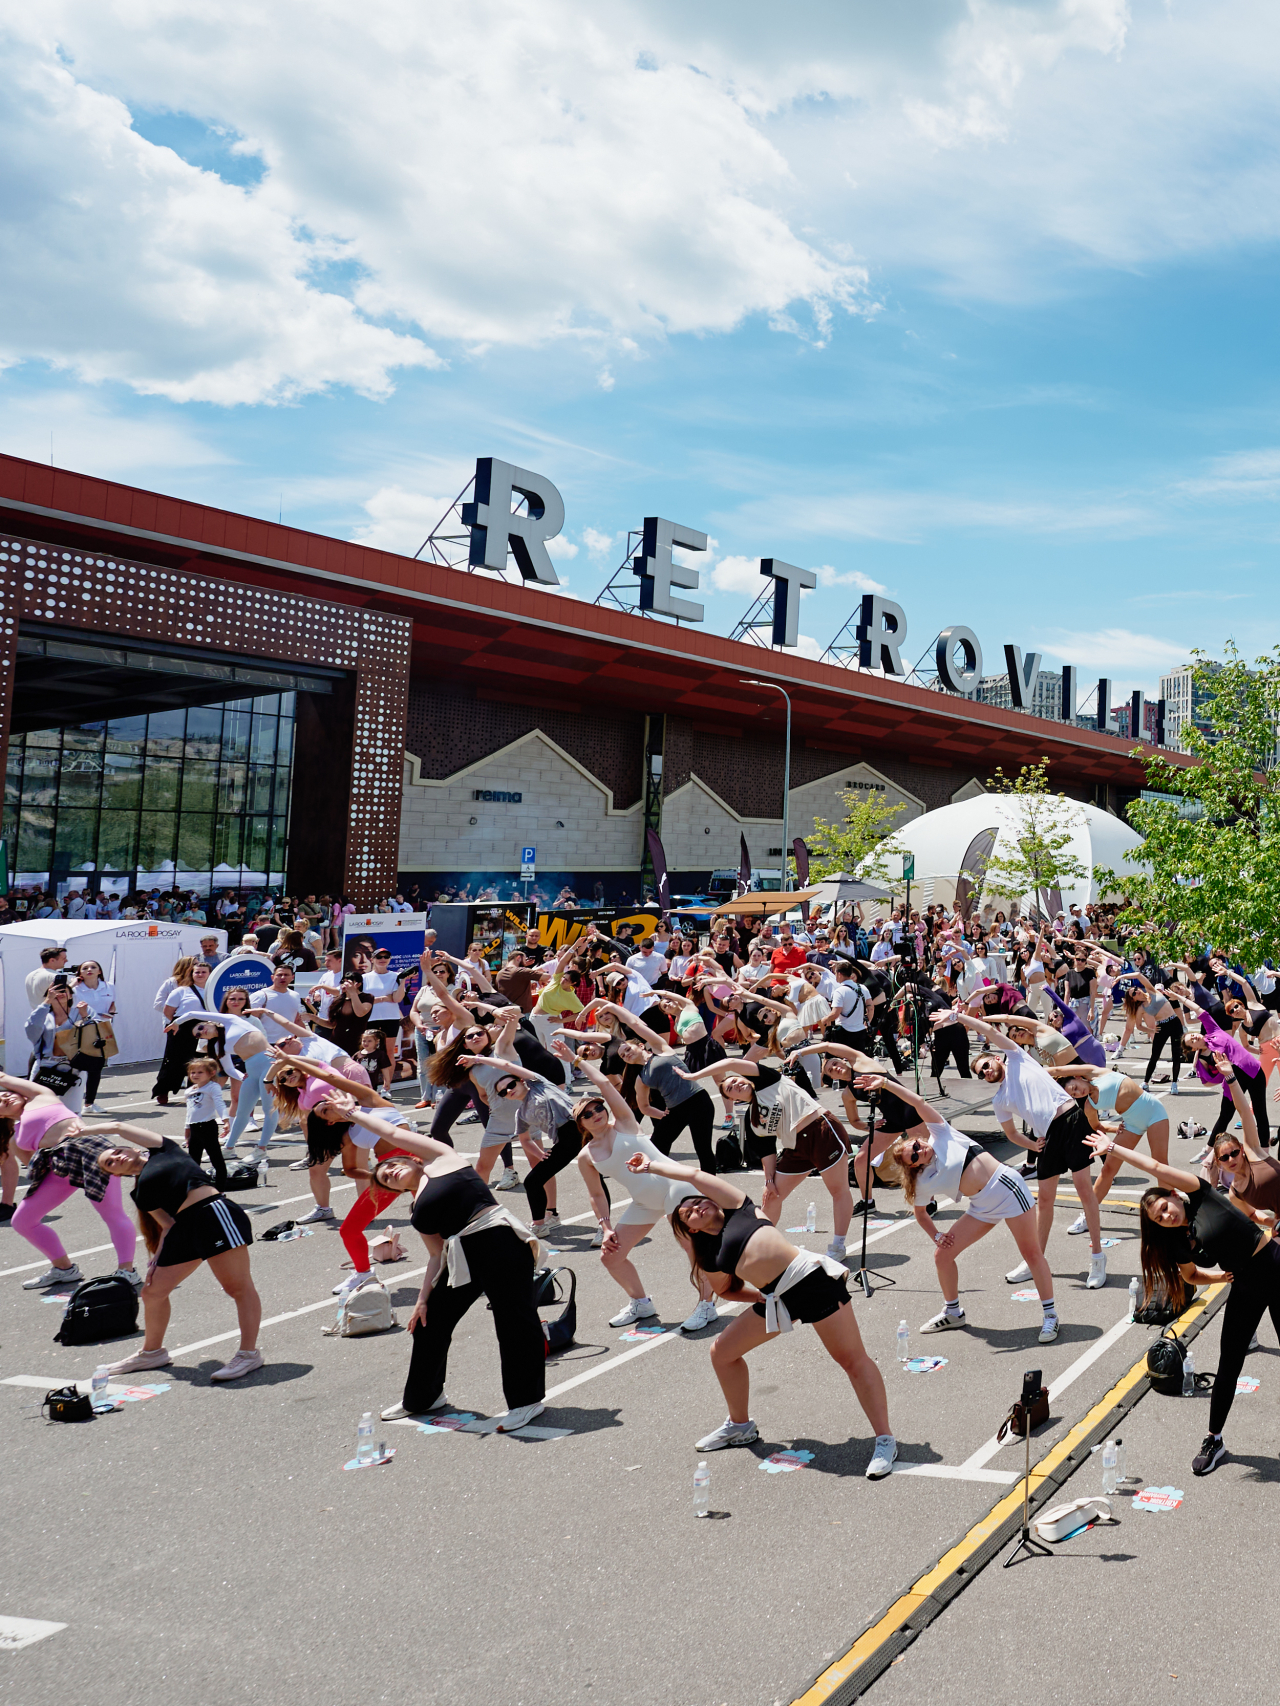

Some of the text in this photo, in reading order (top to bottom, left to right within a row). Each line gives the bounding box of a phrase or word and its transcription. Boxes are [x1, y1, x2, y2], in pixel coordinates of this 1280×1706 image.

[462, 457, 1177, 747] RETROVILLE
[846, 781, 886, 791] BROCARD
[472, 789, 523, 803] reima
[505, 909, 528, 932] WILD
[39, 1075, 55, 1083] TOTE
